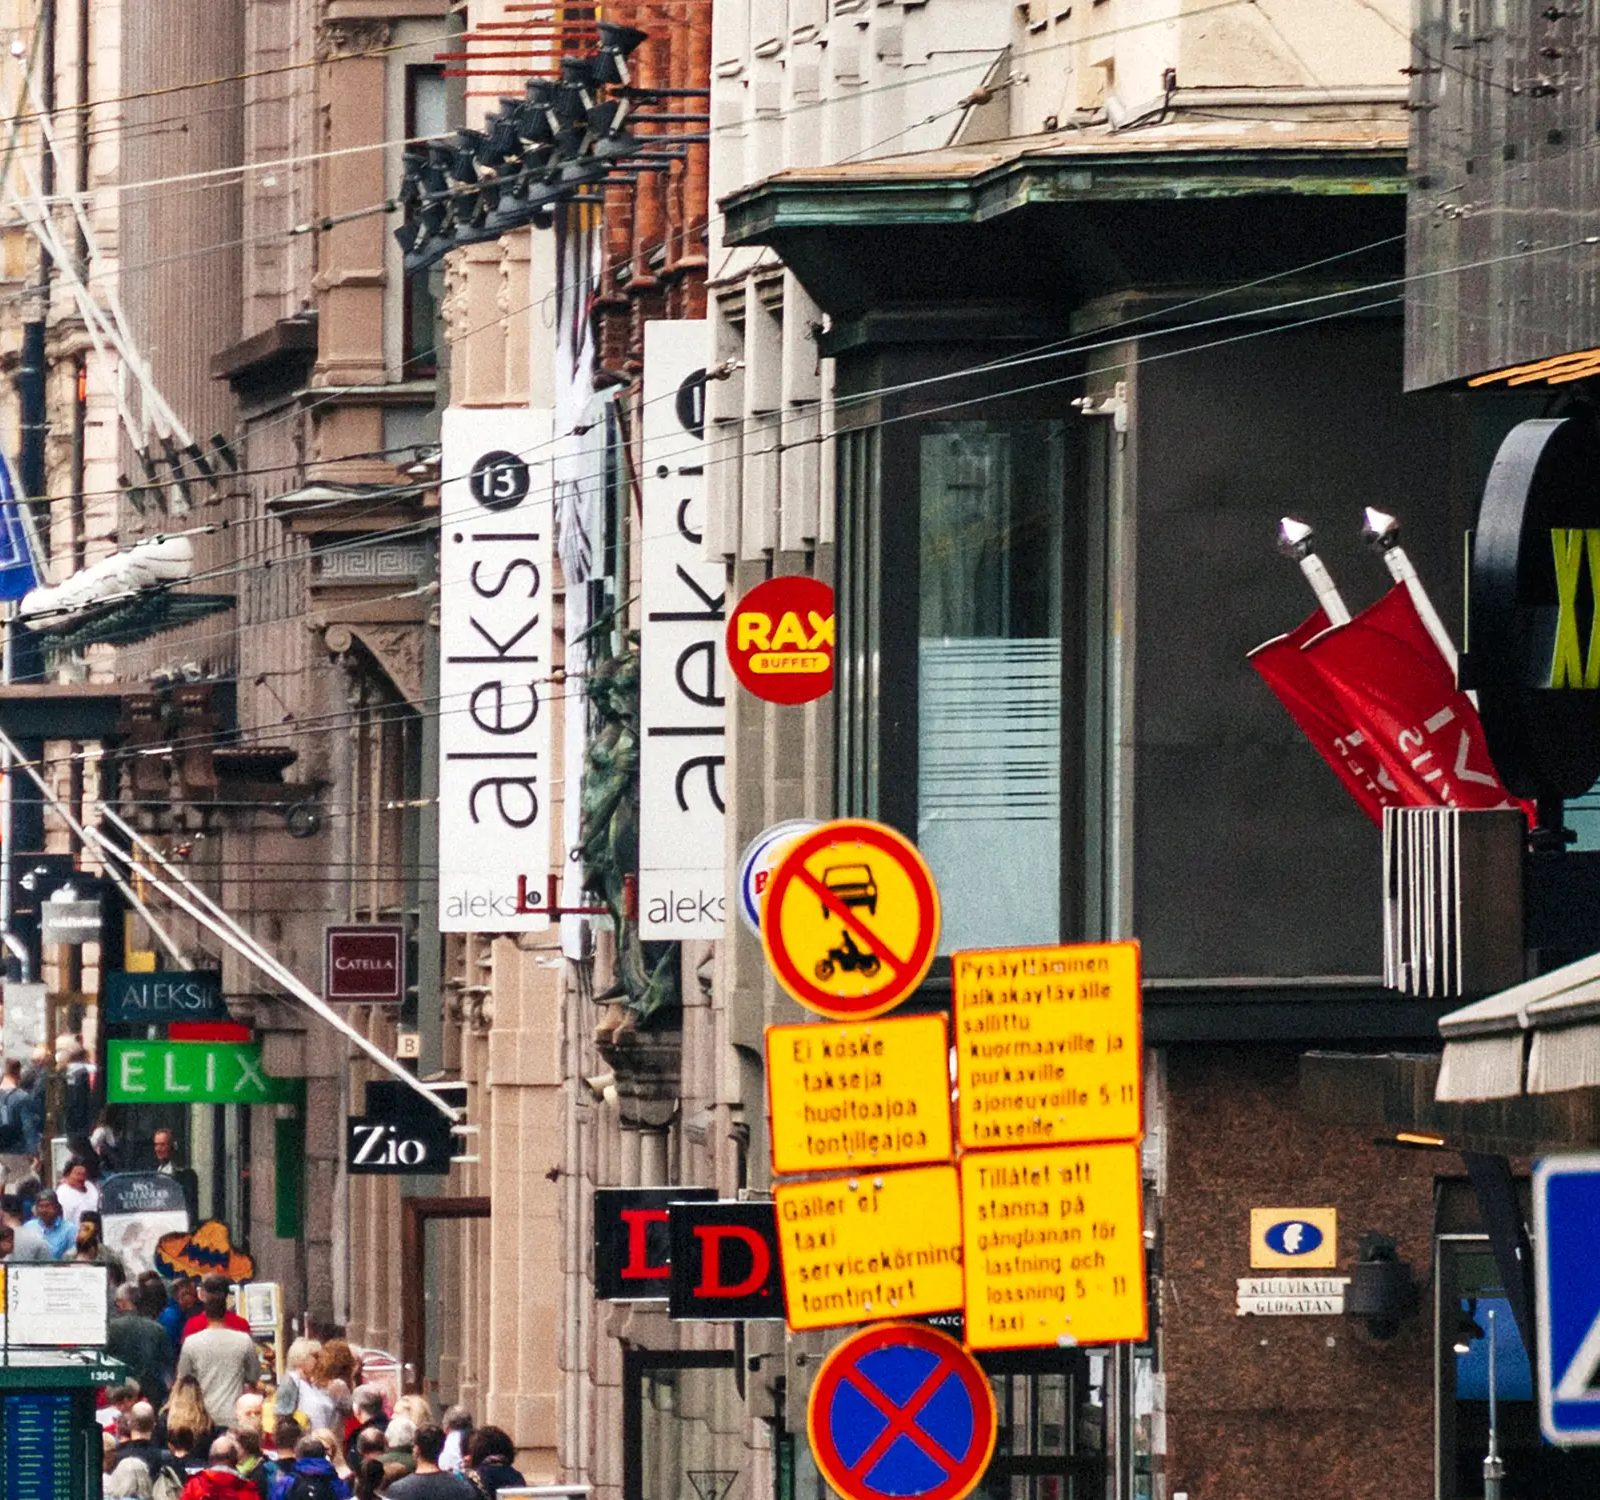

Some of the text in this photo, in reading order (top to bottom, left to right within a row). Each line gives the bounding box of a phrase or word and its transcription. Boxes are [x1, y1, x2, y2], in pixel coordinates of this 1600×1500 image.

[761, 657, 820, 670] BUFFET
[446, 525, 541, 829] aleksi
[335, 956, 394, 972] CATELLA
[793, 1037, 885, 1063] Ei koske
[1107, 1034, 1124, 1054] ja
[971, 1064, 1066, 1087] purkaville
[352, 1127, 426, 1164] Zio
[1061, 1163, 1090, 1184] att
[979, 1197, 1085, 1221] stanna på
[1070, 1251, 1105, 1271] och
[1076, 1279, 1086, 1298] 5
